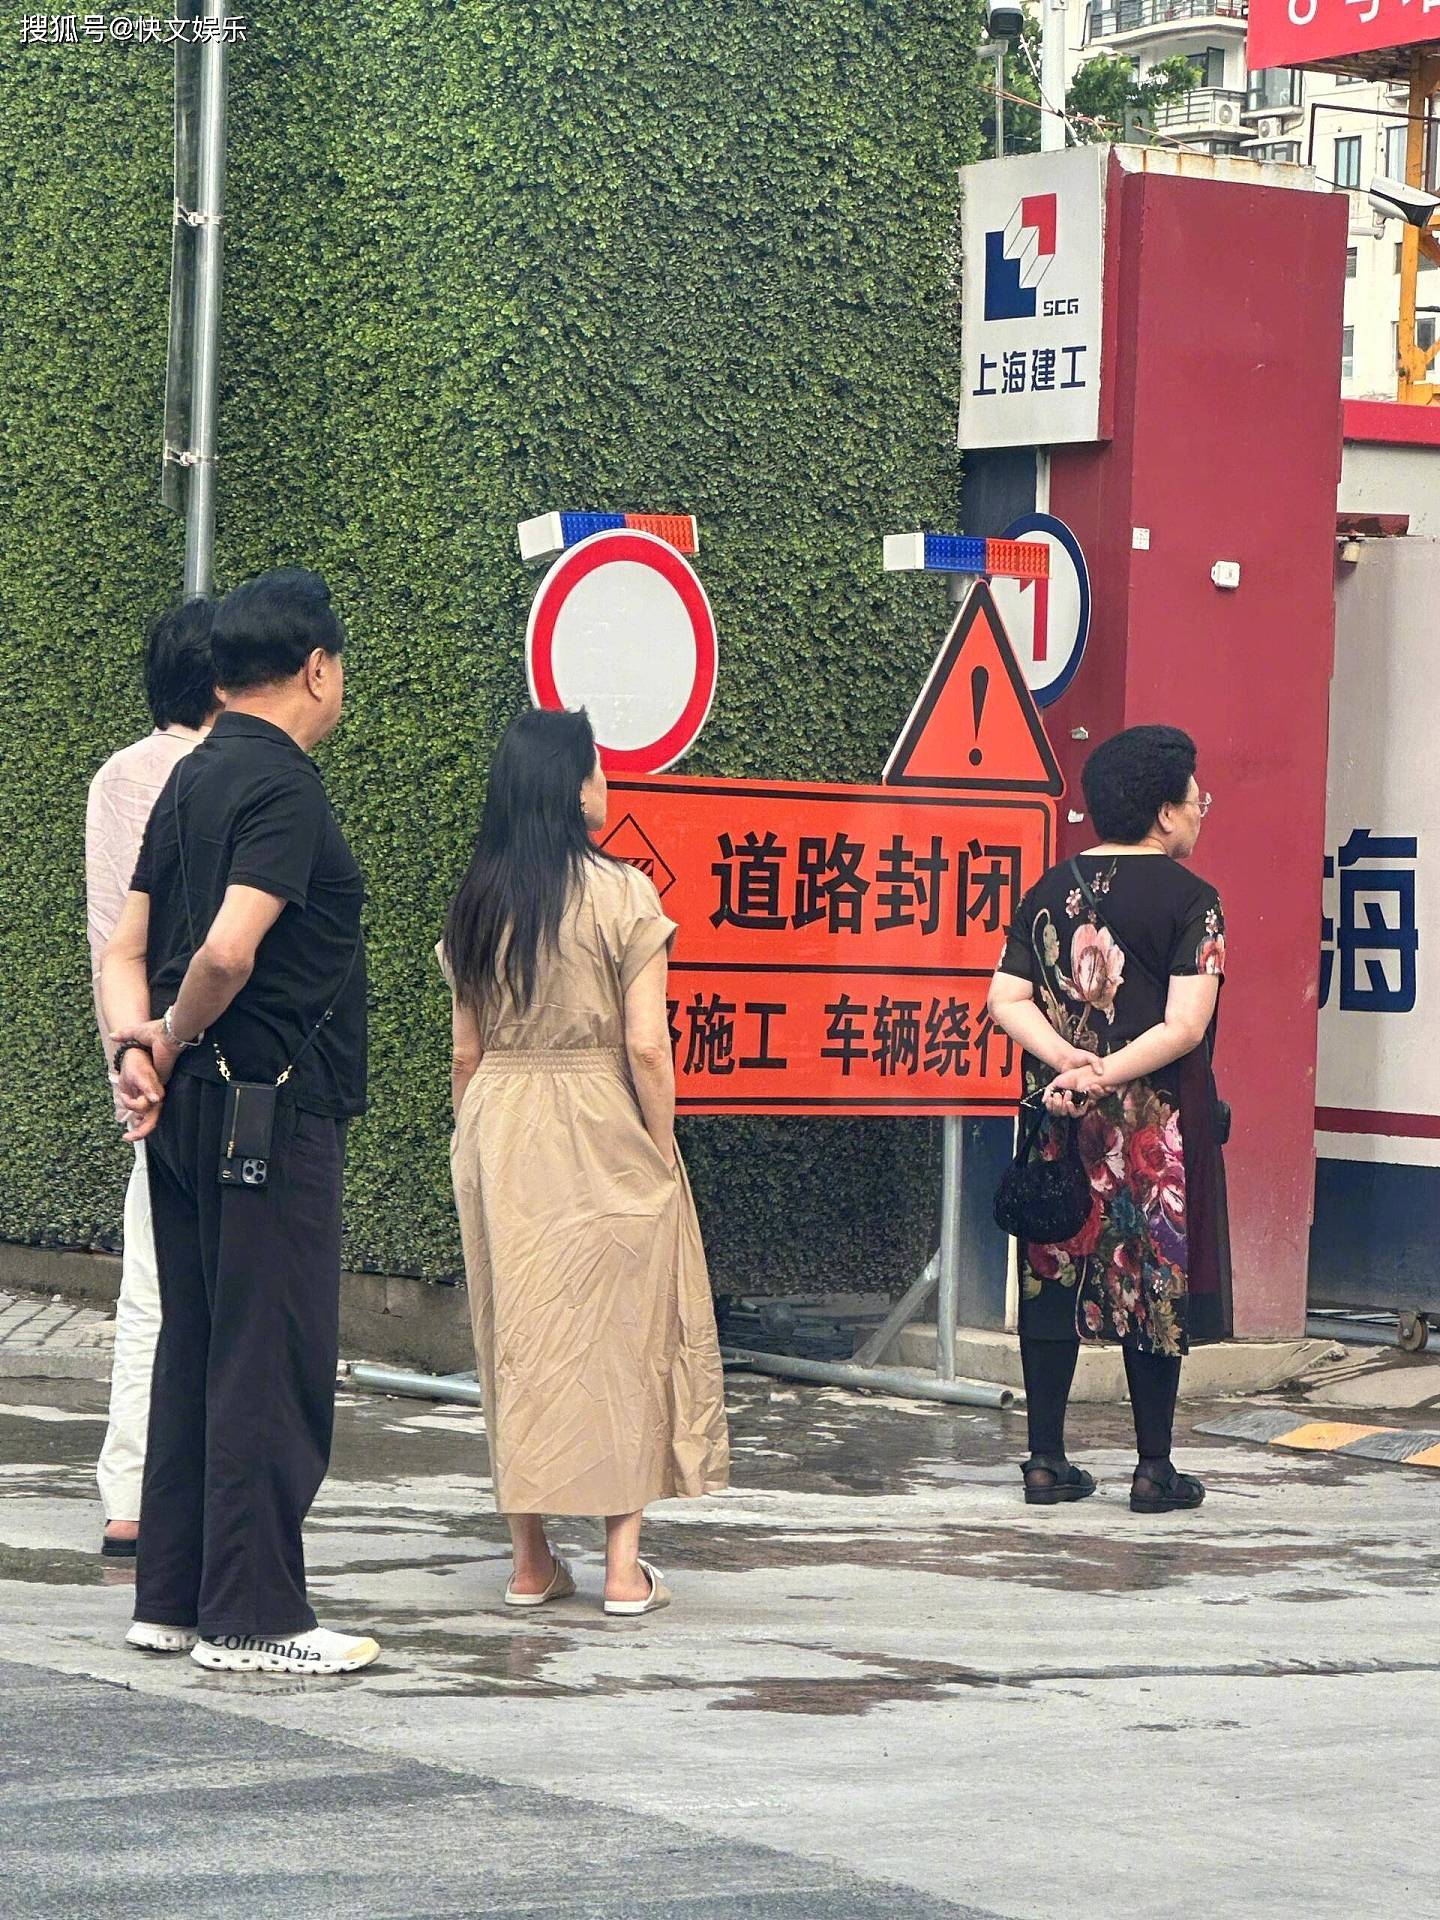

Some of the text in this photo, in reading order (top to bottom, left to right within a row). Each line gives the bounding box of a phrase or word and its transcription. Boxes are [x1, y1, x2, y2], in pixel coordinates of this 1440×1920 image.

[1043, 298, 1080, 317] SCG
[972, 345, 1088, 396] 上海建工
[709, 831, 1022, 937] 道路封闭
